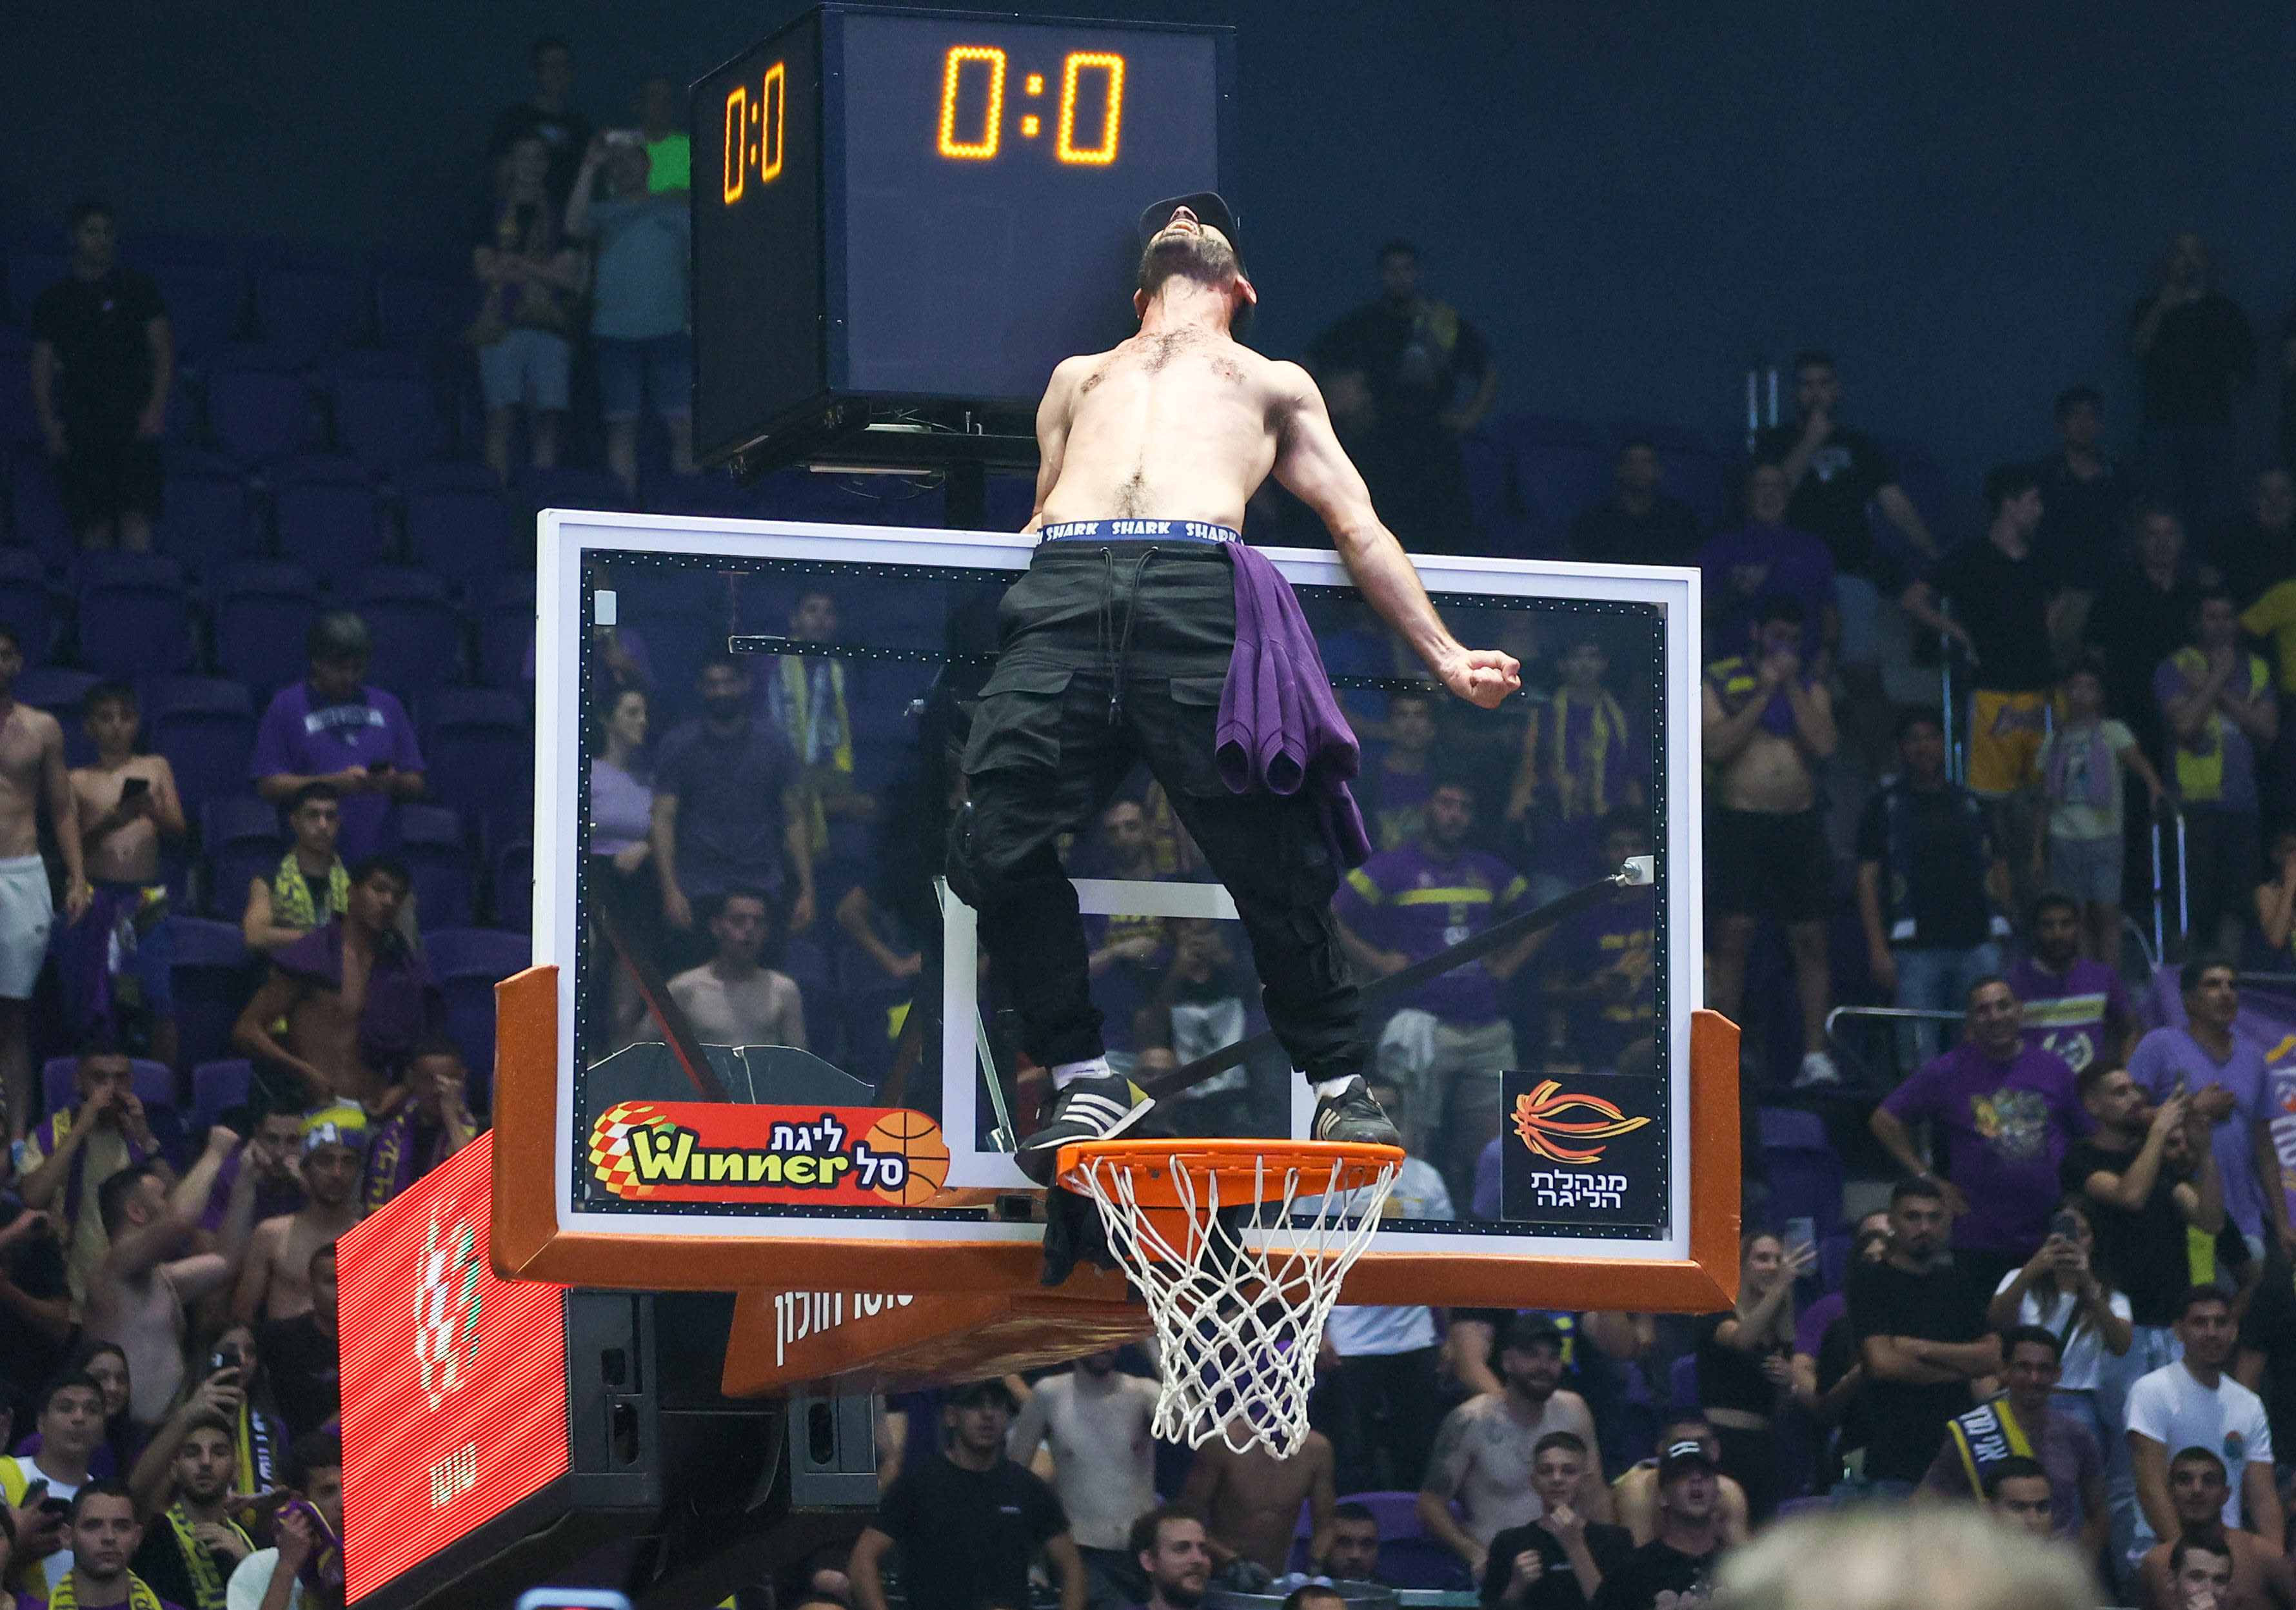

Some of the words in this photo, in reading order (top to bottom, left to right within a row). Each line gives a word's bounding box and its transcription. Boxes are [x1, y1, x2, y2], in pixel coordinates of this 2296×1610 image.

[937, 45, 1126, 164] 0:0
[723, 61, 784, 205] 0:0
[1045, 522, 1099, 542] SHARK
[1111, 520, 1171, 535] SHARK
[770, 1117, 844, 1152] ליגת
[631, 1130, 849, 1184] Winner
[855, 1146, 904, 1186] סל
[1530, 1168, 1628, 1192] מנהלת
[1537, 1187, 1622, 1209] הליגה
